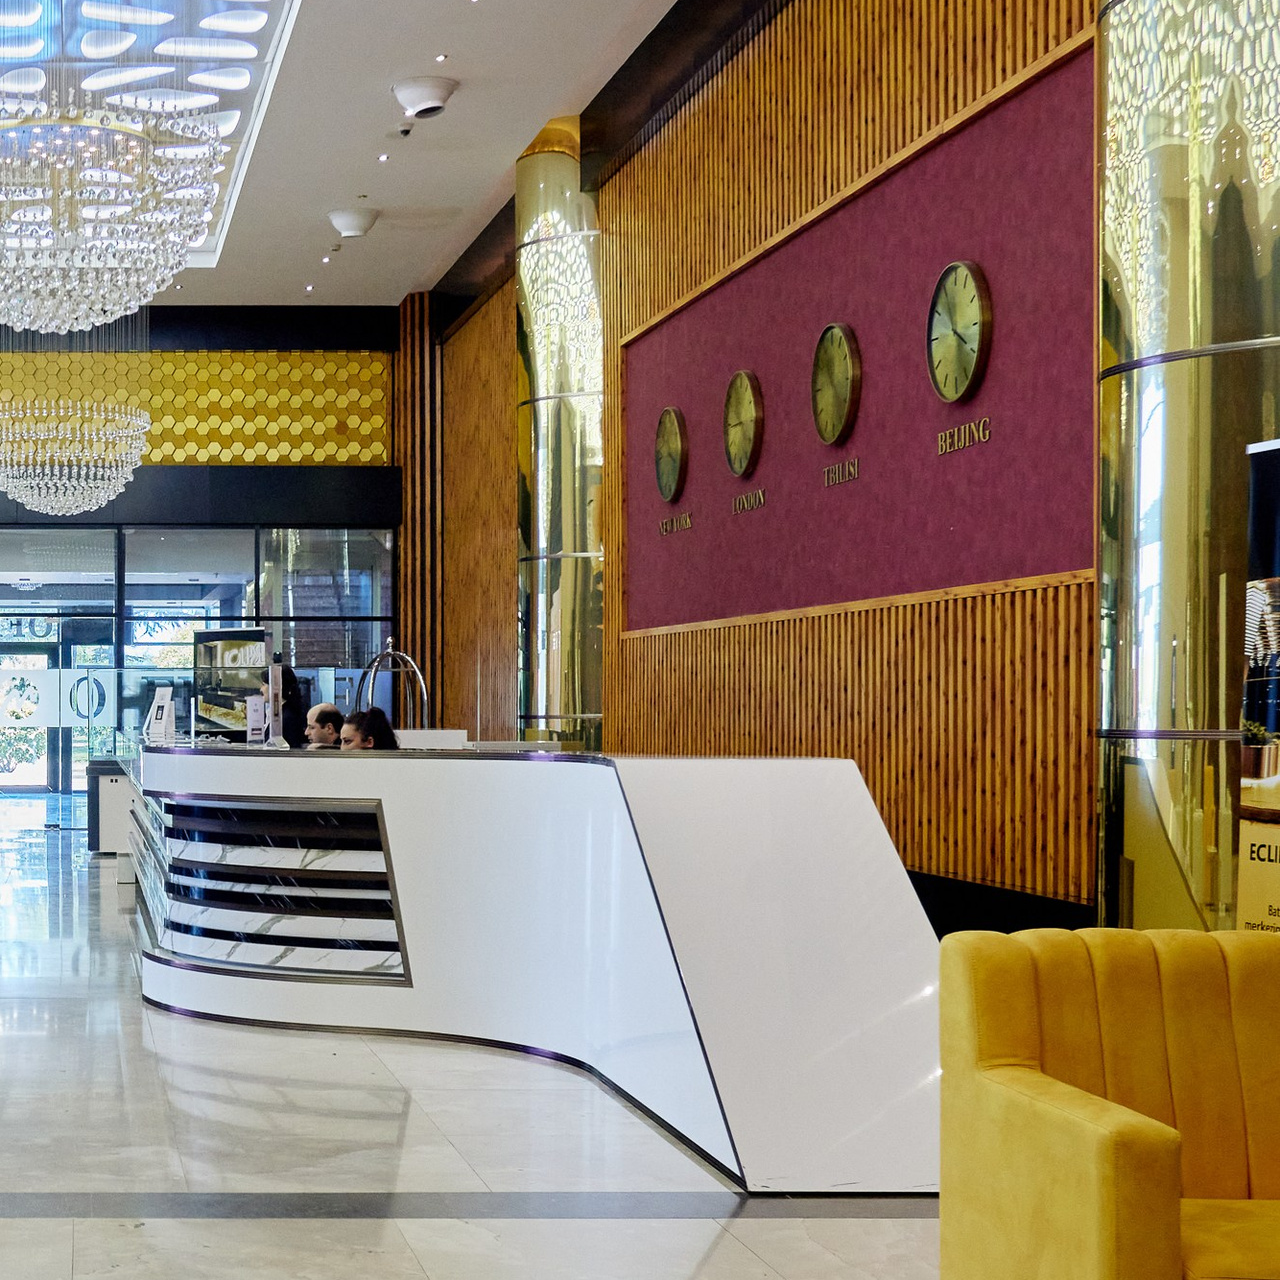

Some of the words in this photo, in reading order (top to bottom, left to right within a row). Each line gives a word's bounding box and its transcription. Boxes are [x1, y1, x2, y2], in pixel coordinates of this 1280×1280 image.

[938, 417, 991, 456] BEIJING
[823, 458, 860, 487] TBILISI
[732, 488, 766, 515] LONDON
[660, 519, 673, 536] NEW
[673, 513, 692, 532] YORK
